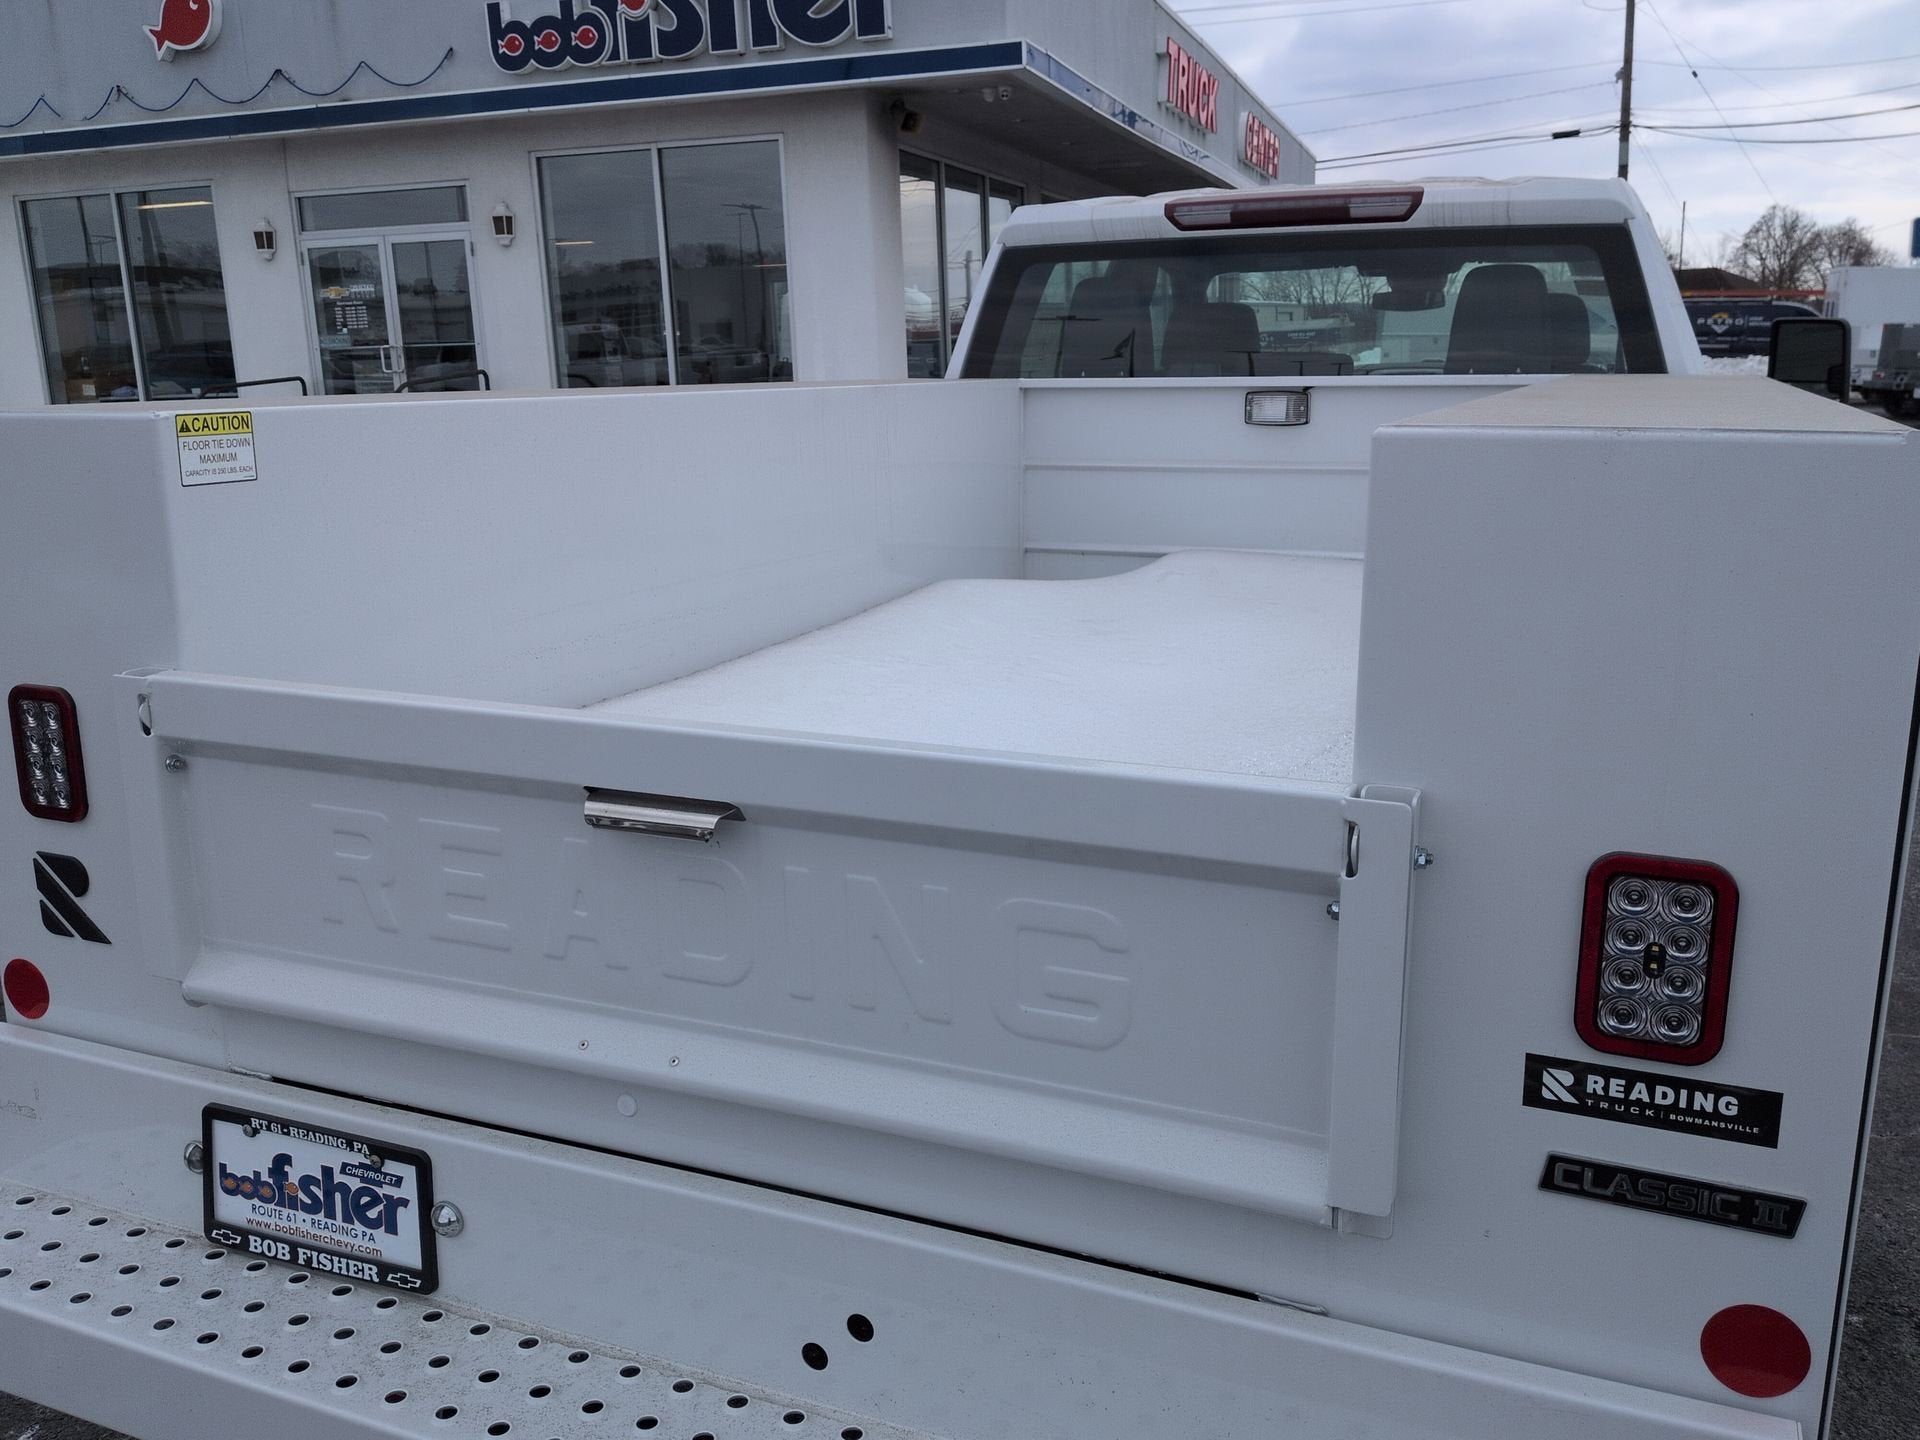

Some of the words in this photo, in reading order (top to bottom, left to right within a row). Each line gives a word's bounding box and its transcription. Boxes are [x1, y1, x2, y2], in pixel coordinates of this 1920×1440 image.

[1166, 36, 1219, 134] TRUCK
[1245, 112, 1281, 180] CENTER
[183, 440, 210, 451] FLOOR
[212, 439, 225, 449] TIE
[226, 437, 251, 448] DOWN
[191, 415, 250, 433] CAUTION
[199, 452, 238, 464] MAXIMUM
[310, 803, 1132, 1050] READING
[1585, 1074, 1739, 1117] READING
[1585, 1098, 1655, 1118] TRUCK
[1669, 1113, 1760, 1134] BOWMANSVILLE
[250, 1117, 269, 1133] RT
[353, 1140, 370, 1155] PA
[345, 1165, 397, 1185] CHEVROLET
[1553, 1162, 1743, 1222] CLASSIC
[245, 1216, 383, 1258] www.bobfisherchevy.com
[251, 1203, 284, 1222] ROUTE
[286, 1210, 298, 1225] 61
[310, 1218, 359, 1239] READING
[361, 1230, 376, 1244] PA
[248, 1235, 291, 1261] BOB
[296, 1247, 380, 1283] FISHER
